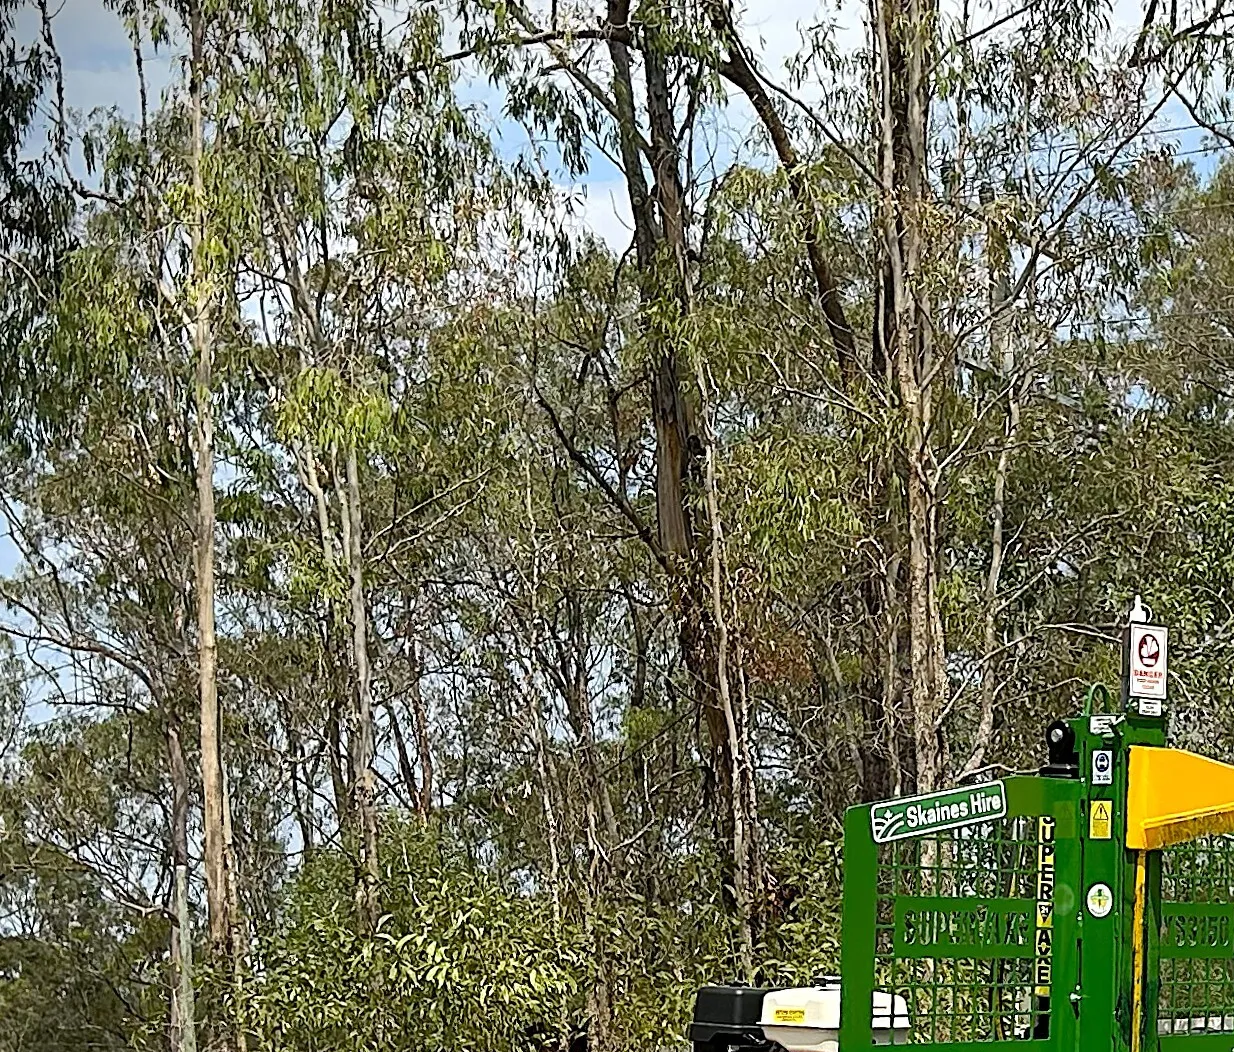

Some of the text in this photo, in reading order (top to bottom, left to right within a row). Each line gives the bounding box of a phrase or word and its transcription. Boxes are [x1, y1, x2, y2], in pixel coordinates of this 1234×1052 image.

[1134, 669, 1163, 679] DANGER
[906, 792, 1001, 828] Skaines Hire
